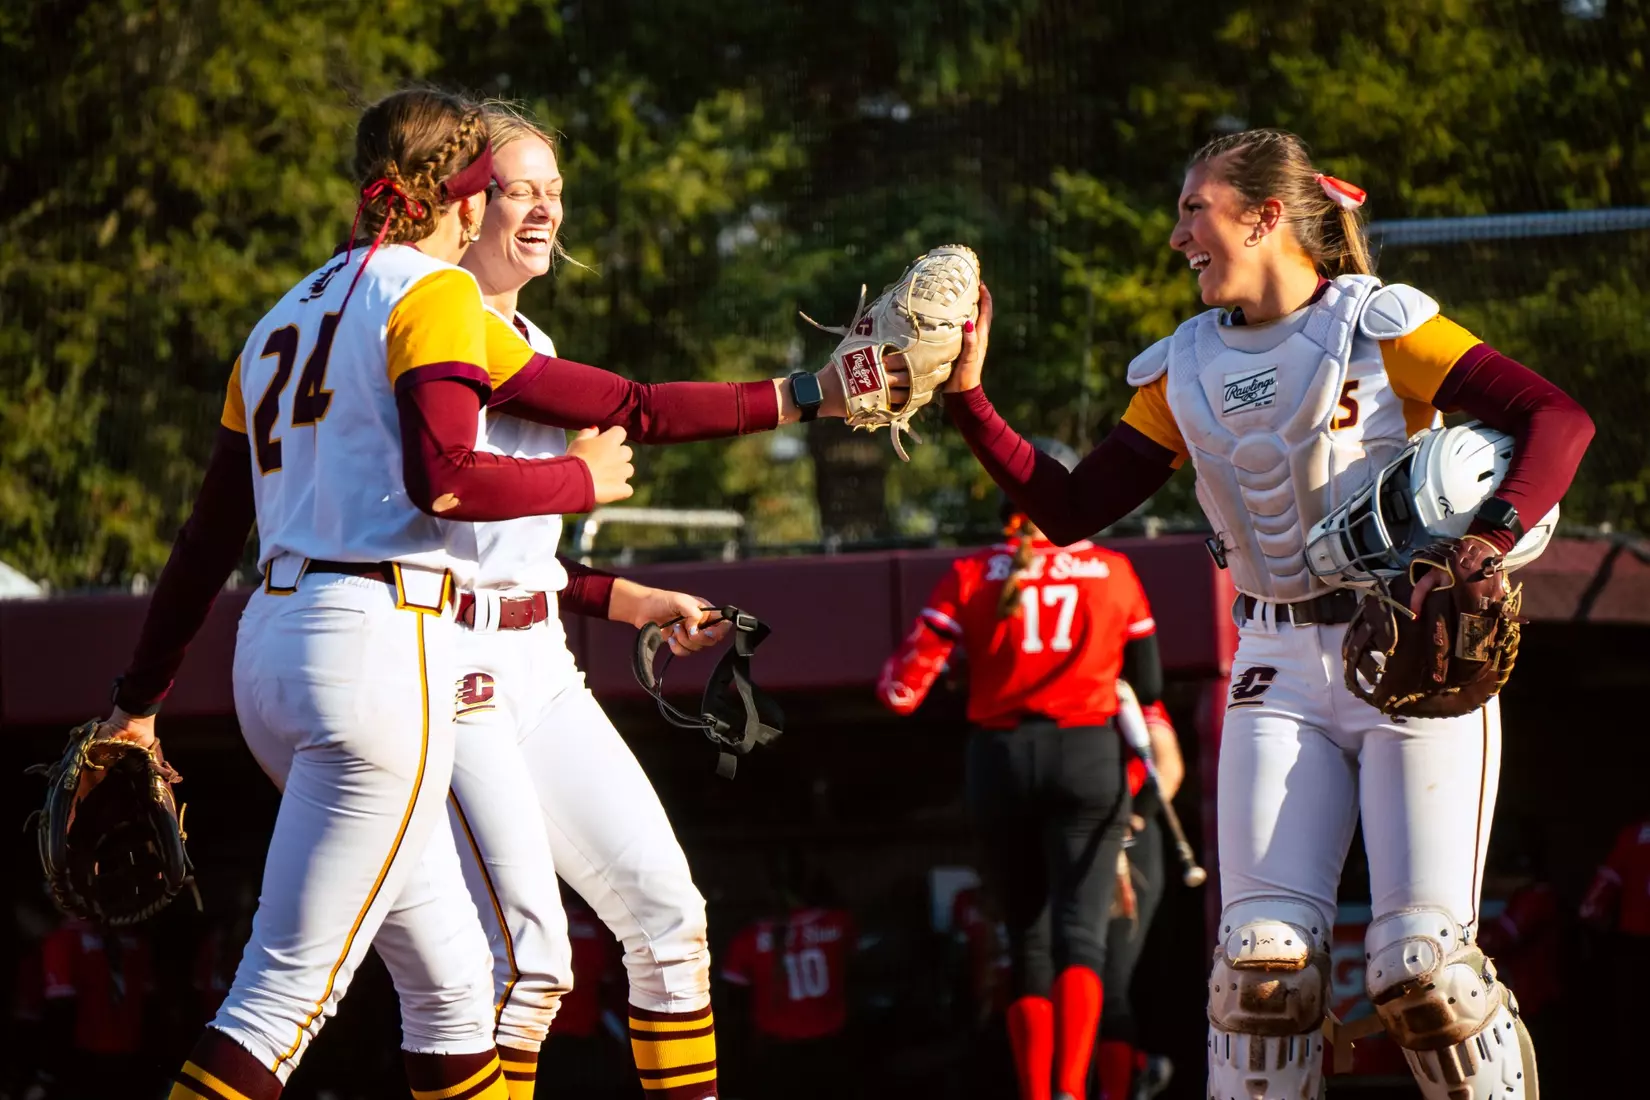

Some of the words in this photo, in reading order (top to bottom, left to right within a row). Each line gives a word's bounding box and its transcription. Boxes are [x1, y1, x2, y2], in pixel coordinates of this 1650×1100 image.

[253, 312, 340, 477] 24
[1225, 377, 1276, 402] Rawlings
[1329, 380, 1360, 431] 5
[1020, 584, 1079, 654] 17
[784, 948, 830, 1002] 10
